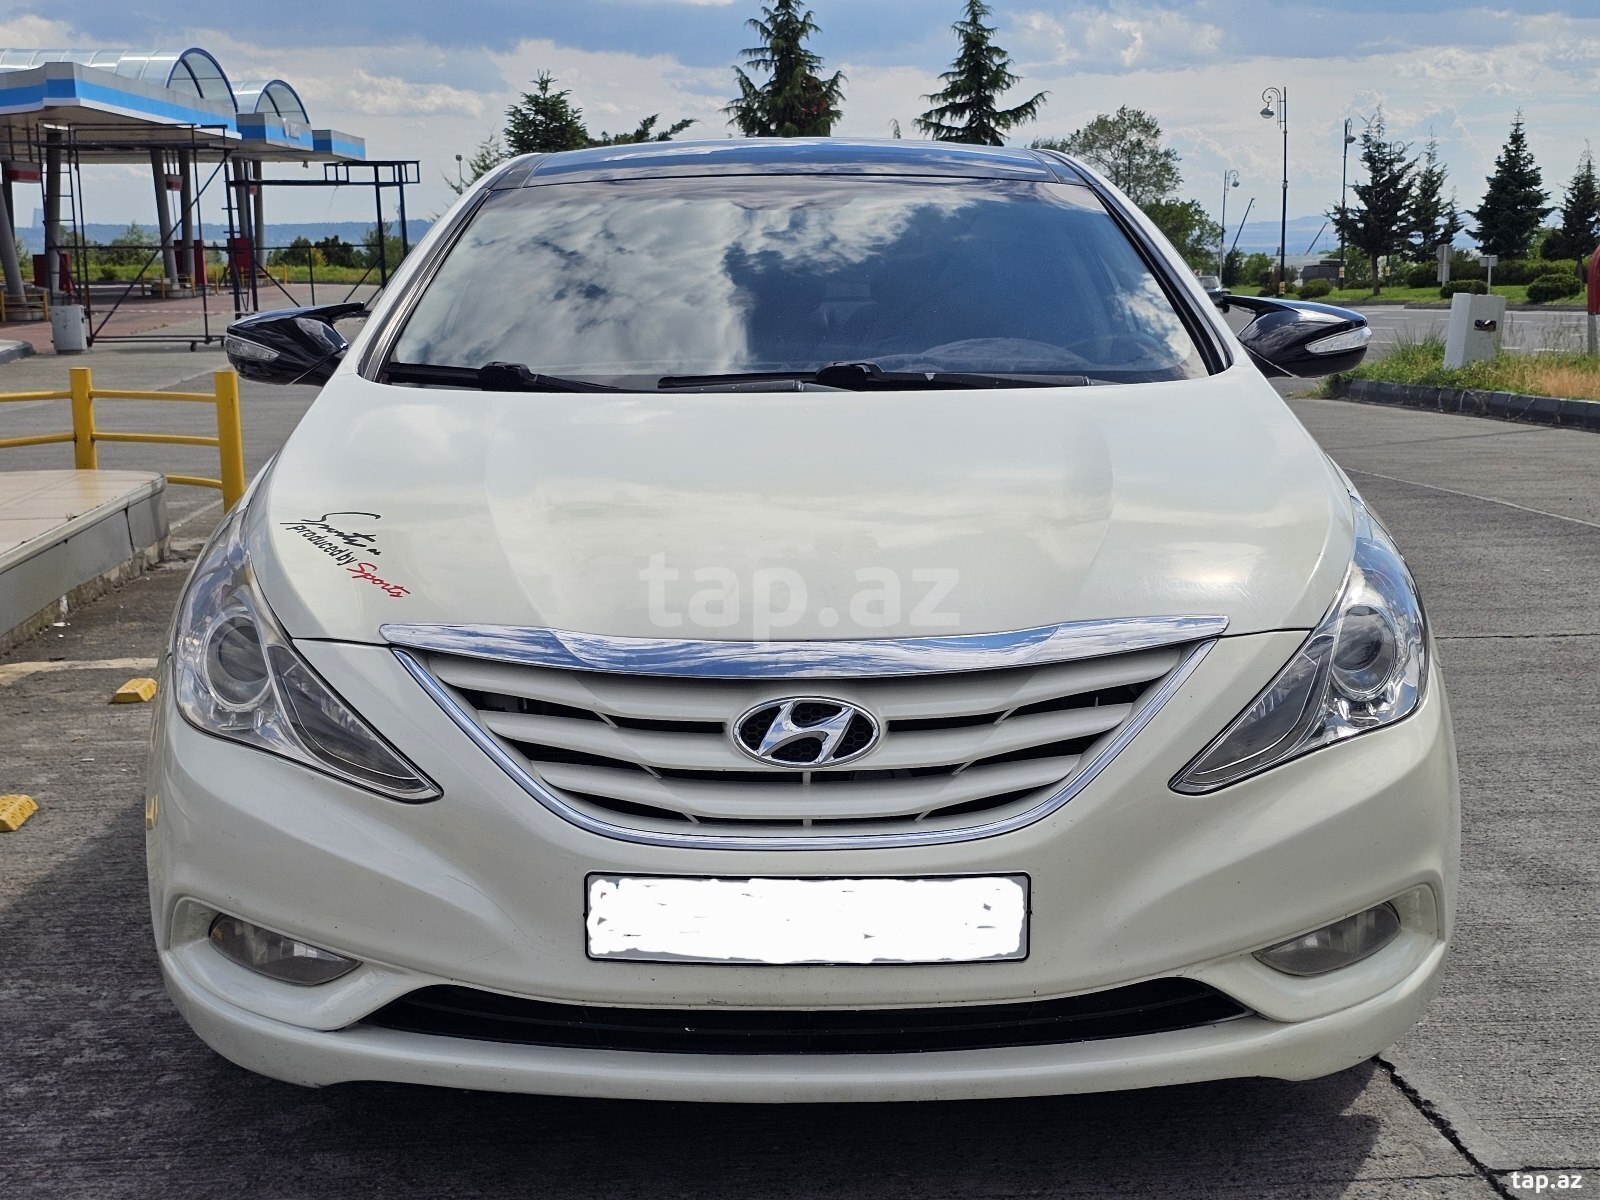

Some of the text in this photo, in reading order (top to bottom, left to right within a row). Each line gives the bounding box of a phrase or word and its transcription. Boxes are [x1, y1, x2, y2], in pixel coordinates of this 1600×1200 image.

[286, 525, 411, 598] produced by Sports
